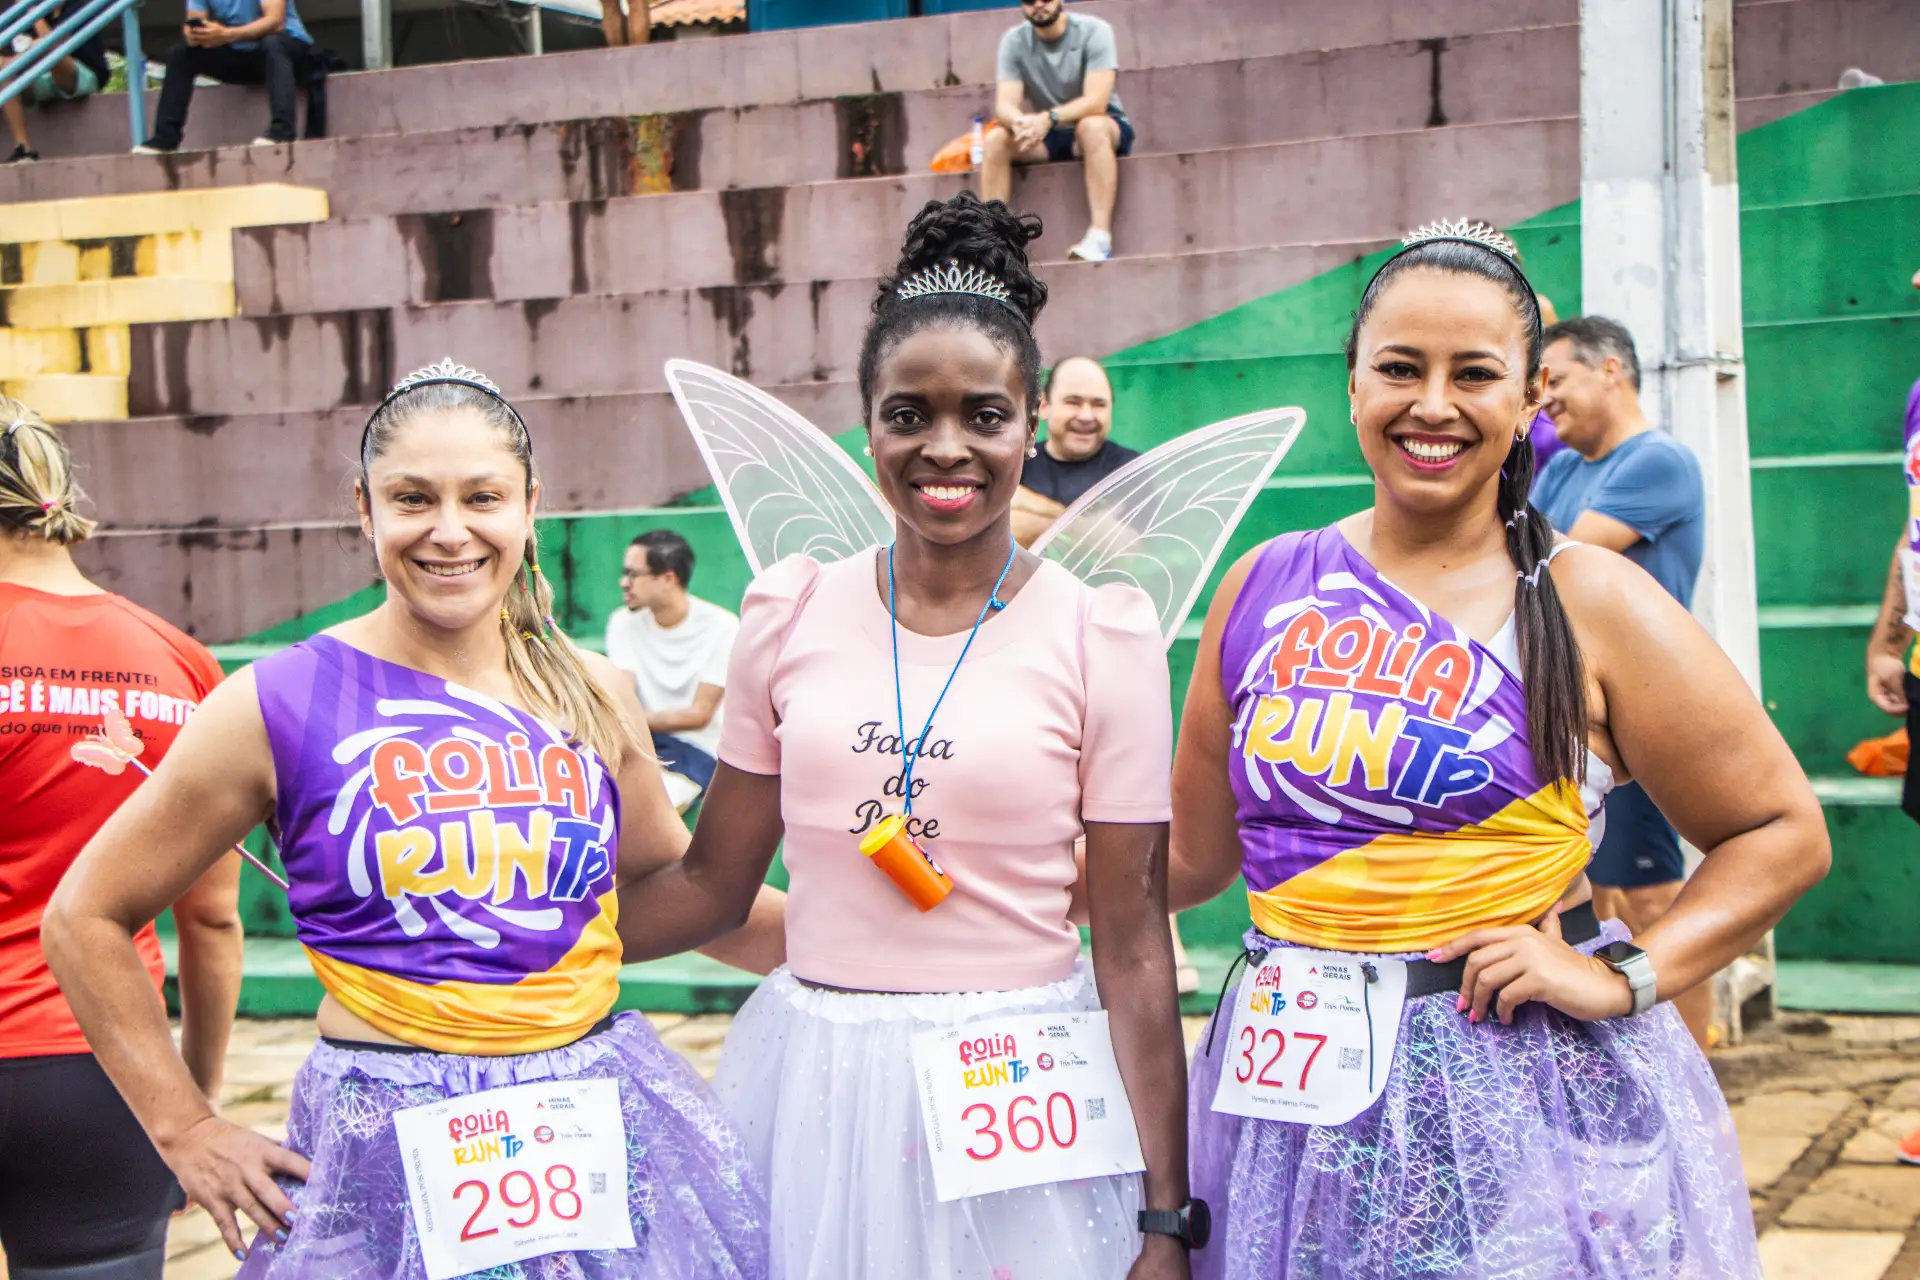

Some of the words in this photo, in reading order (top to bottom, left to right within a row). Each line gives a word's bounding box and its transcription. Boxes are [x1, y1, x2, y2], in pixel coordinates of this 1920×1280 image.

[2, 666, 46, 678] SIGA
[50, 668, 75, 681] EM
[81, 670, 158, 686] FRENTE!
[30, 679, 46, 713] É
[48, 685, 120, 716] MAIS
[0, 722, 26, 735] do
[31, 723, 62, 736] que
[852, 721, 954, 760] Fada
[883, 762, 930, 799] do
[1323, 965, 1348, 973] MINAS
[1323, 972, 1351, 981] GERAIS
[1236, 1025, 1328, 1091] 327
[961, 1091, 1077, 1161] 360
[452, 1164, 582, 1243] 298
